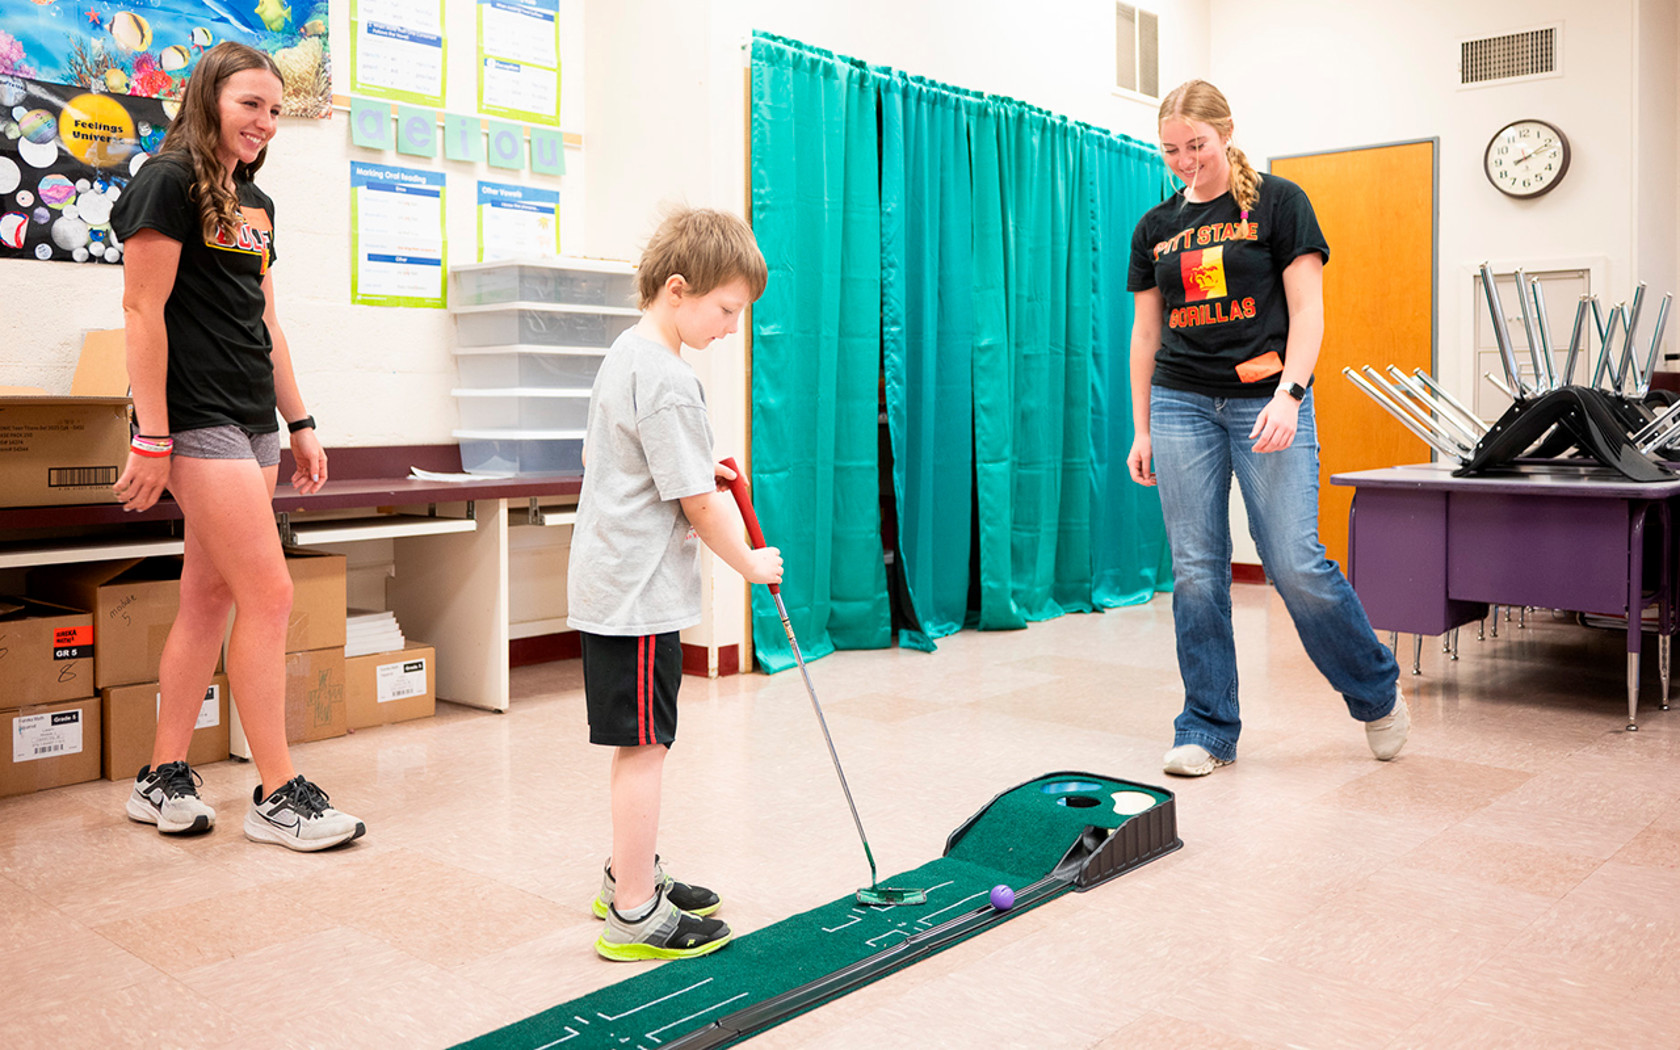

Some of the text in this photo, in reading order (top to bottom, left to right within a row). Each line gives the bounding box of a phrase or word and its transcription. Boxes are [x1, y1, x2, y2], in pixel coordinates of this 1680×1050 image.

[74, 119, 124, 133] Feelings
[357, 108, 558, 167] a e i o u
[1519, 128, 1530, 138] 12
[1536, 130, 1541, 139] 1
[1507, 136, 1516, 144] 11
[1544, 138, 1552, 147] 2
[1497, 146, 1509, 155] 10
[1549, 151, 1557, 159] 3
[1494, 158, 1502, 167] 9
[1544, 163, 1552, 171] 4
[355, 167, 427, 185] Marking Oral Reading
[1499, 170, 1508, 179] 8
[1534, 173, 1543, 182] 5
[1511, 177, 1517, 186] 7
[1522, 178, 1531, 187] 6
[481, 186, 499, 196] Other
[1153, 228, 1195, 262] PITT
[1169, 297, 1257, 328] GORILLAS
[110, 594, 137, 619] module
[121, 611, 131, 627] 5
[55, 648, 78, 657] GR 5
[53, 715, 72, 723] Grade
